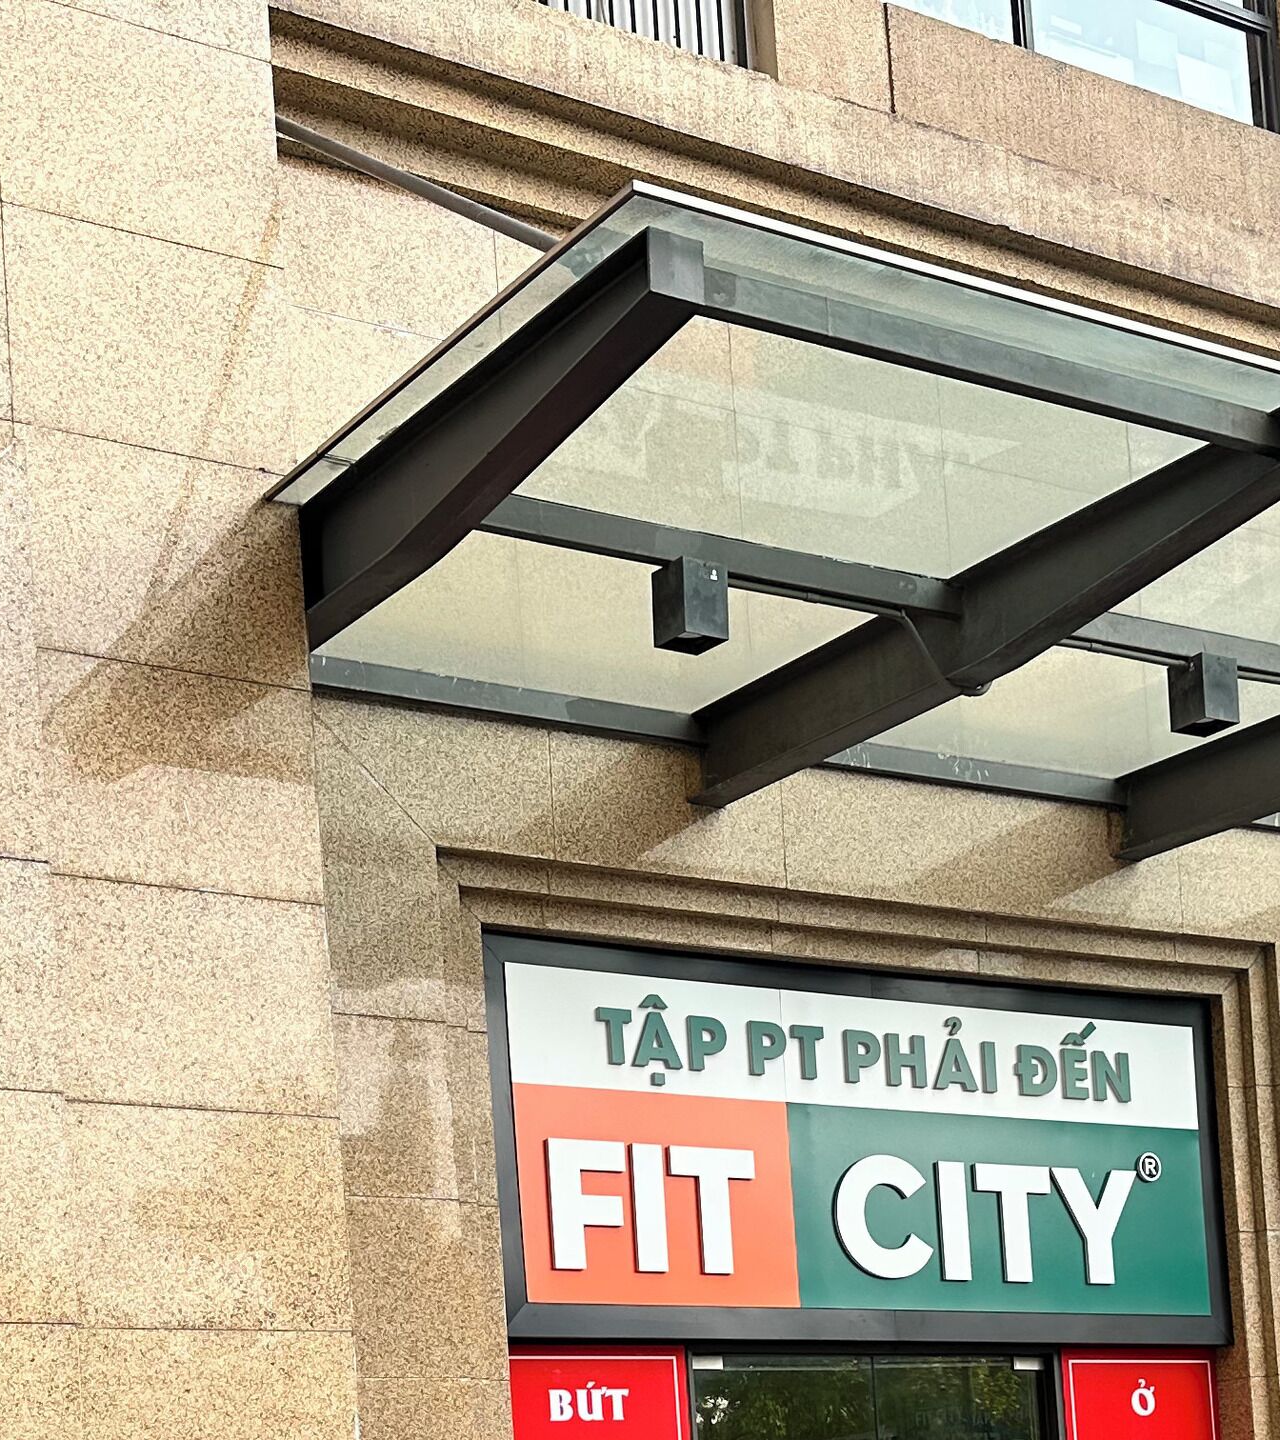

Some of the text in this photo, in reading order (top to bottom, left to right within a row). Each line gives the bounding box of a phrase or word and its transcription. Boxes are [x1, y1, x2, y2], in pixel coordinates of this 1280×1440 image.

[595, 993, 1133, 1104] TẬP PT PHẢI ĐẾN
[543, 1136, 756, 1277] FIT
[833, 1152, 1138, 1287] CITY
[548, 1381, 629, 1422] BỨT
[1131, 1379, 1156, 1416] Ở
